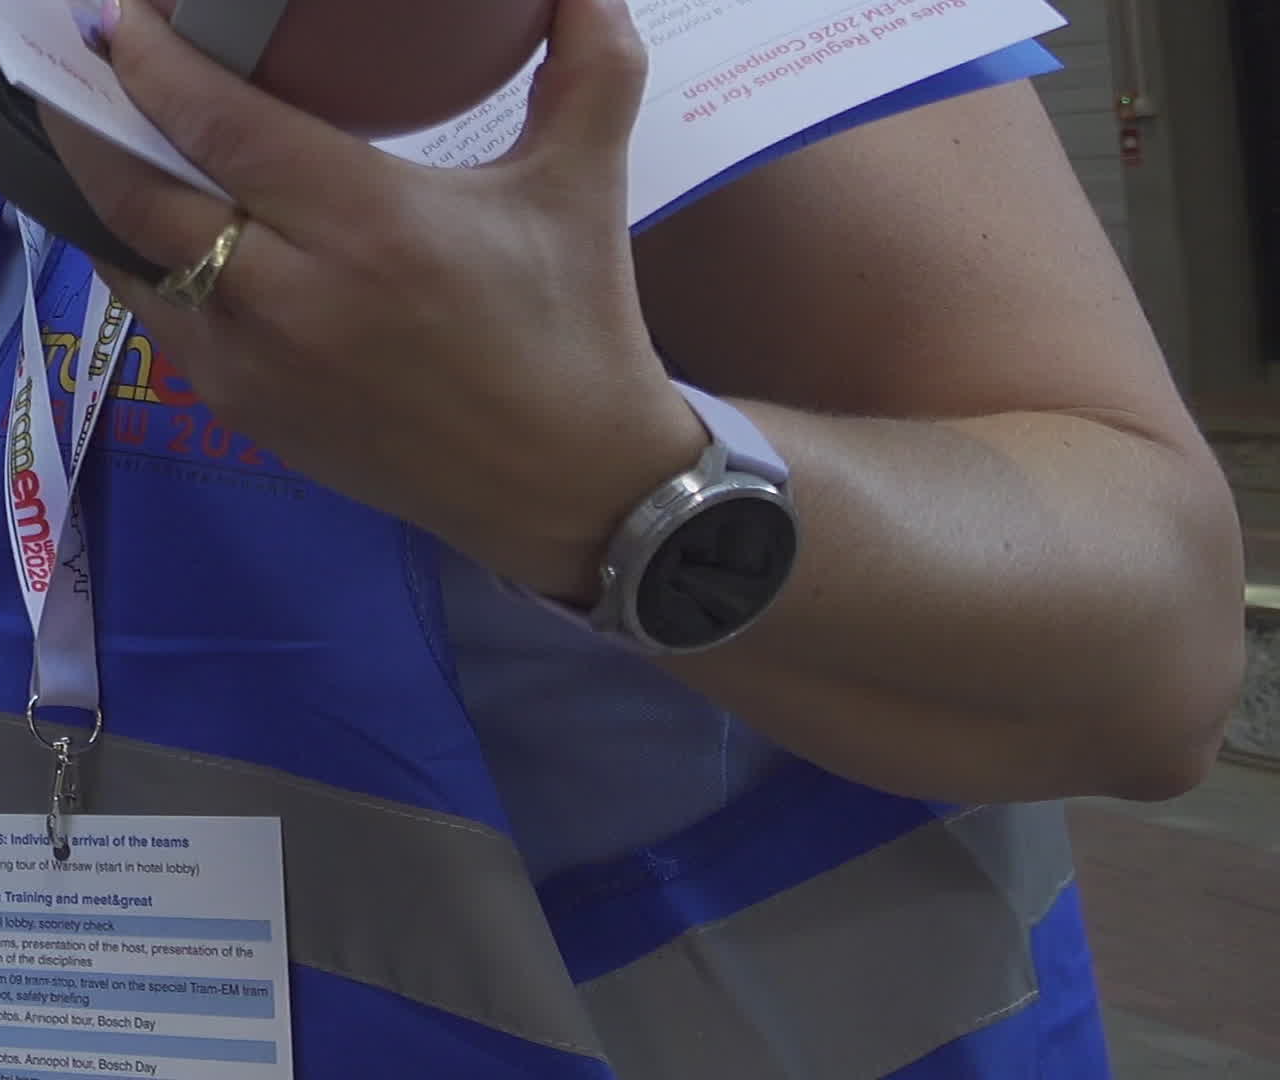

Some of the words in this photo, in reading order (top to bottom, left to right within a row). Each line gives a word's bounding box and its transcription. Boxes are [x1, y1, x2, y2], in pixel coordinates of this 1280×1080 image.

[809, 17, 856, 43] 2026
[872, 17, 906, 38] and
[681, 36, 806, 98] Competition
[752, 30, 869, 90] Regulations
[721, 84, 750, 104] for
[681, 102, 717, 124] the
[421, 135, 447, 157] and
[22, 542, 49, 593] 2026
[72, 835, 109, 847] arrival
[112, 835, 126, 847] of
[128, 836, 148, 847] the
[151, 837, 190, 848] teams
[16, 860, 36, 870] tour
[38, 860, 50, 870] of
[51, 861, 93, 871] Warsaw
[95, 862, 122, 876] (start
[124, 863, 135, 872] in
[137, 863, 163, 873] hotel
[166, 863, 201, 877] lobby)
[5, 891, 53, 906] Training
[56, 893, 79, 904] and
[82, 894, 153, 908] meet&great
[39, 919, 80, 933] sobriety
[83, 920, 115, 931] check
[21, 938, 86, 952] presentation
[88, 940, 100, 952] of
[102, 941, 119, 952] the
[121, 942, 148, 954] host,
[151, 943, 218, 957] presentation
[221, 945, 234, 957] of
[236, 947, 254, 958] the
[5, 954, 17, 964] of
[18, 954, 35, 965] the
[37, 955, 93, 968] disciplines
[80, 978, 109, 990] travel
[112, 980, 126, 991] on
[128, 980, 146, 992] the
[148, 981, 188, 994] special
[190, 982, 239, 996] Tram-EM
[242, 985, 269, 997] tram
[16, 990, 48, 1004] safety
[50, 992, 90, 1007] briefing
[24, 1011, 69, 1025] Annopol
[71, 1014, 95, 1026] tour,
[98, 1016, 132, 1029] Bosch
[134, 1017, 156, 1032] Day
[25, 1054, 70, 1069] Annopol
[72, 1057, 96, 1070] tour,
[98, 1059, 133, 1072] Bosch
[135, 1061, 157, 1076] Day
